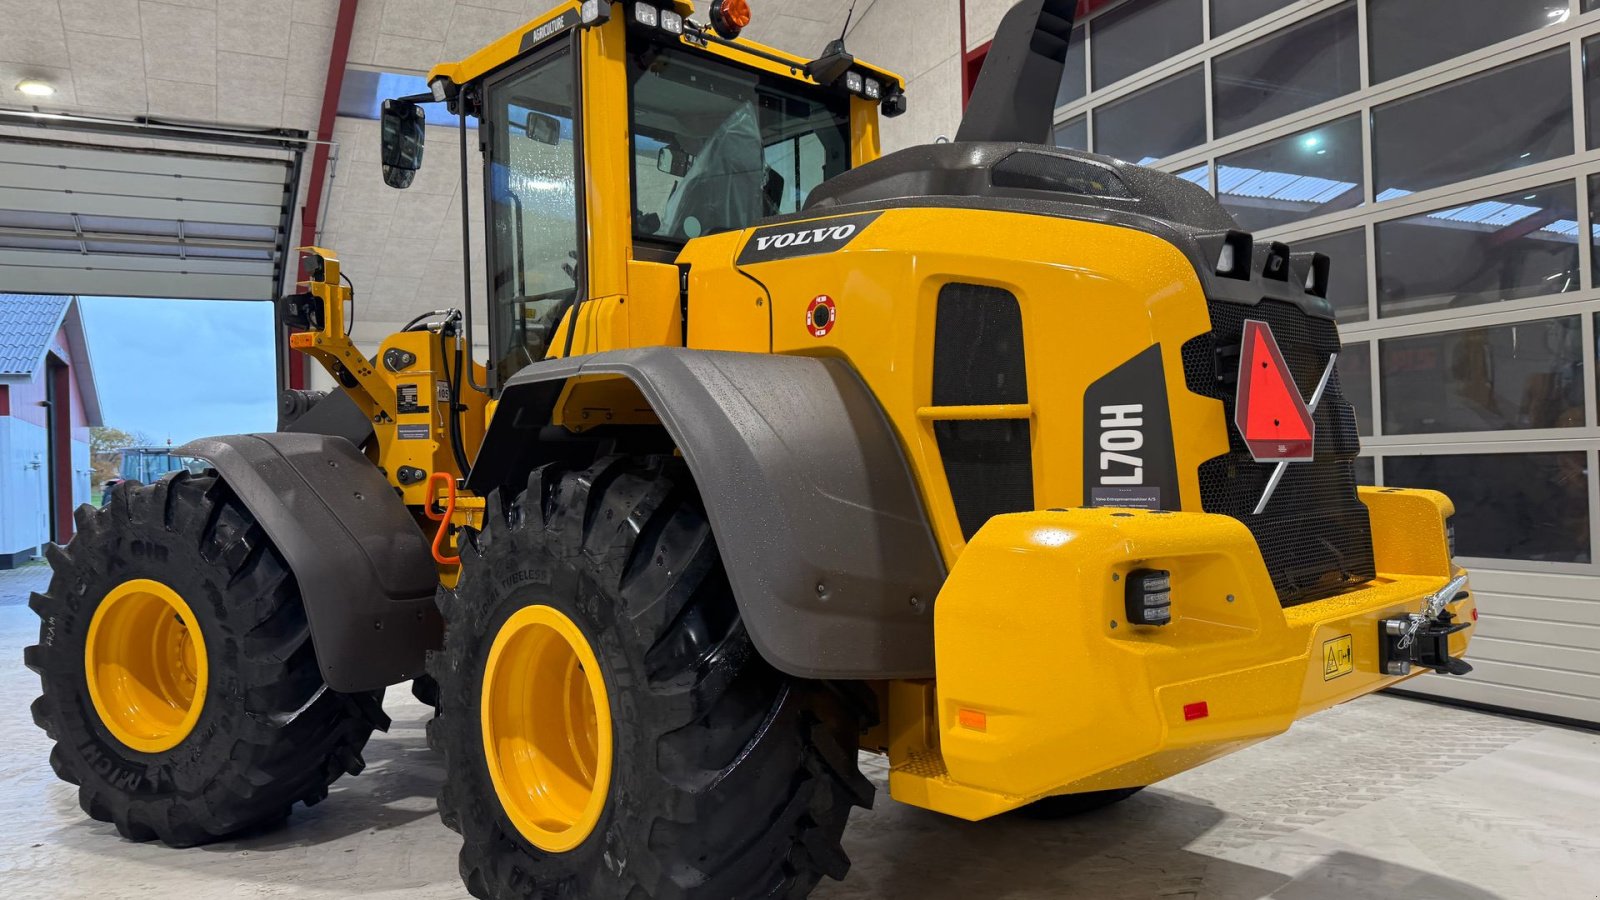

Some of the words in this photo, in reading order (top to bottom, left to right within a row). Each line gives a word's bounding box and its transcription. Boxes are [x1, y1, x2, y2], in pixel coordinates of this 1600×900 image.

[533, 15, 565, 44] AGRICULTURE
[756, 224, 856, 251] VOLVO
[1100, 404, 1144, 485] L70H
